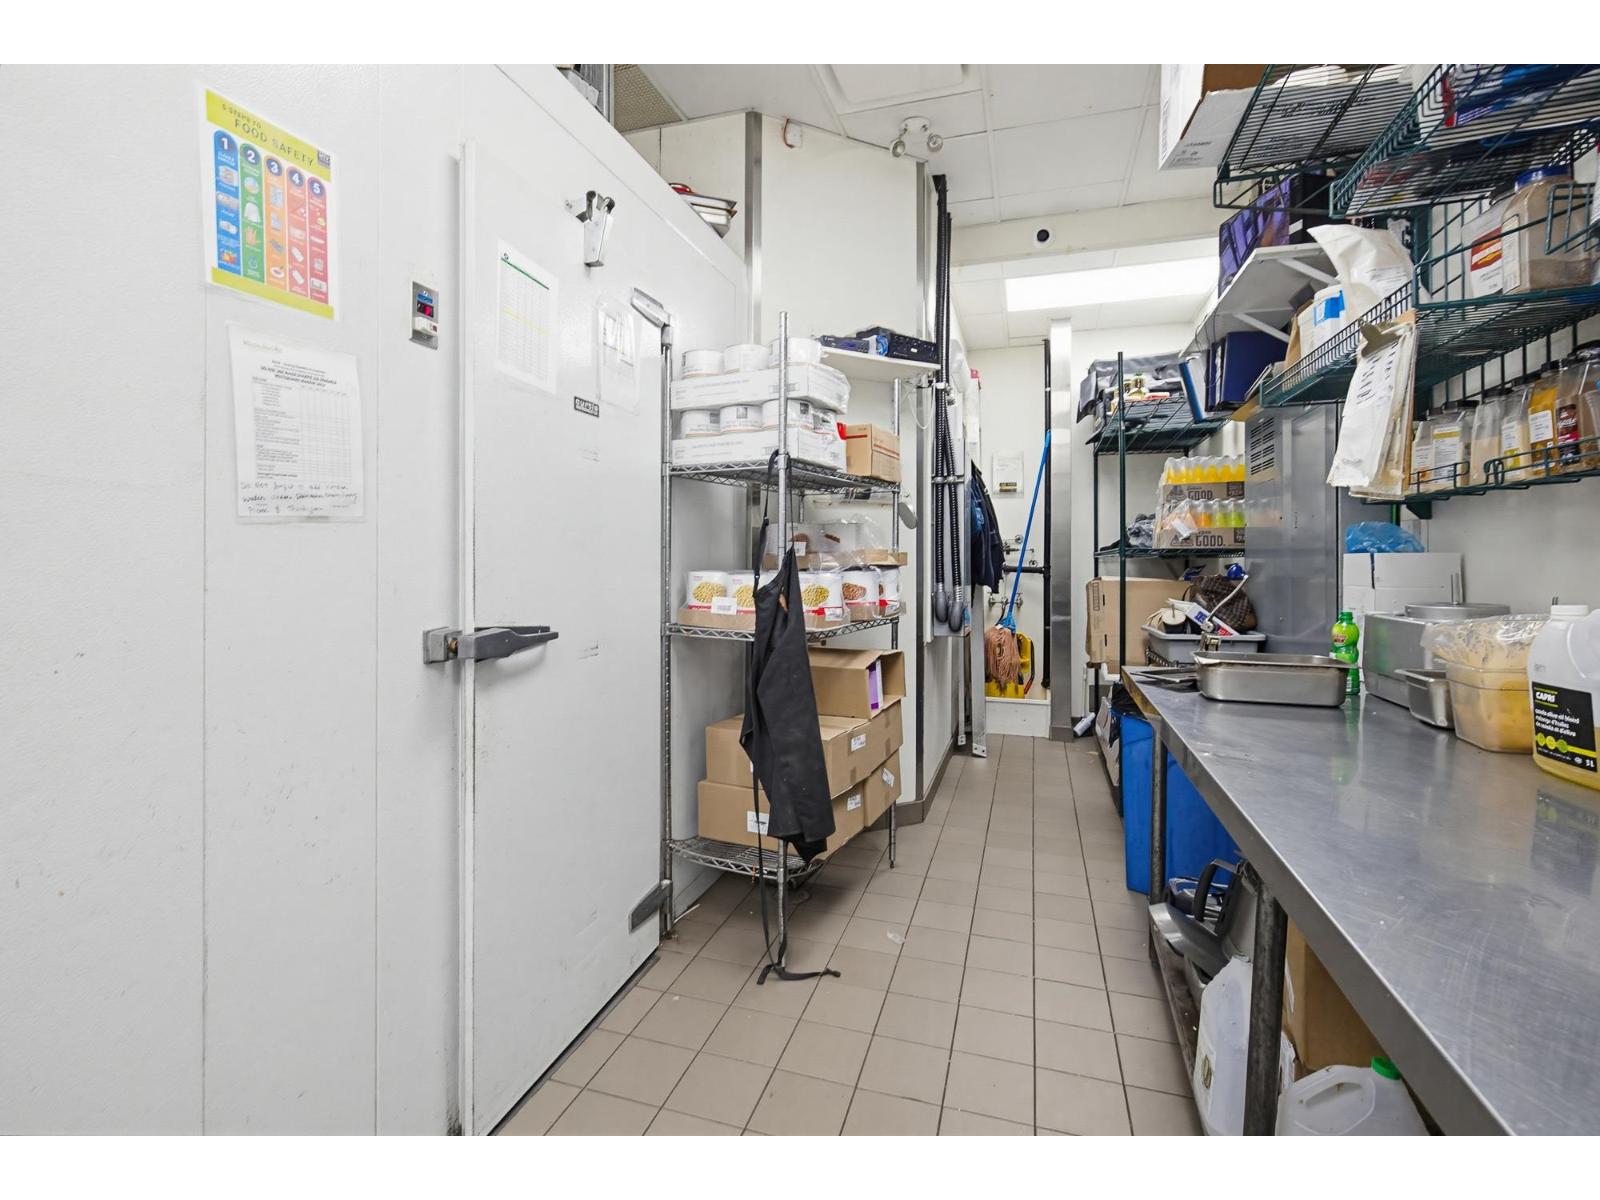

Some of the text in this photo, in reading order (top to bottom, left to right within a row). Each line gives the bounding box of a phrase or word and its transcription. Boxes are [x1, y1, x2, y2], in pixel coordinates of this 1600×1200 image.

[221, 137, 228, 150] 1
[234, 118, 268, 143] FOOD
[272, 138, 314, 167] SAFETY
[247, 150, 256, 163] 2
[270, 161, 278, 173] 3
[292, 173, 300, 184] 4
[313, 182, 321, 194] 5
[1535, 691, 1556, 703] CAPRI
